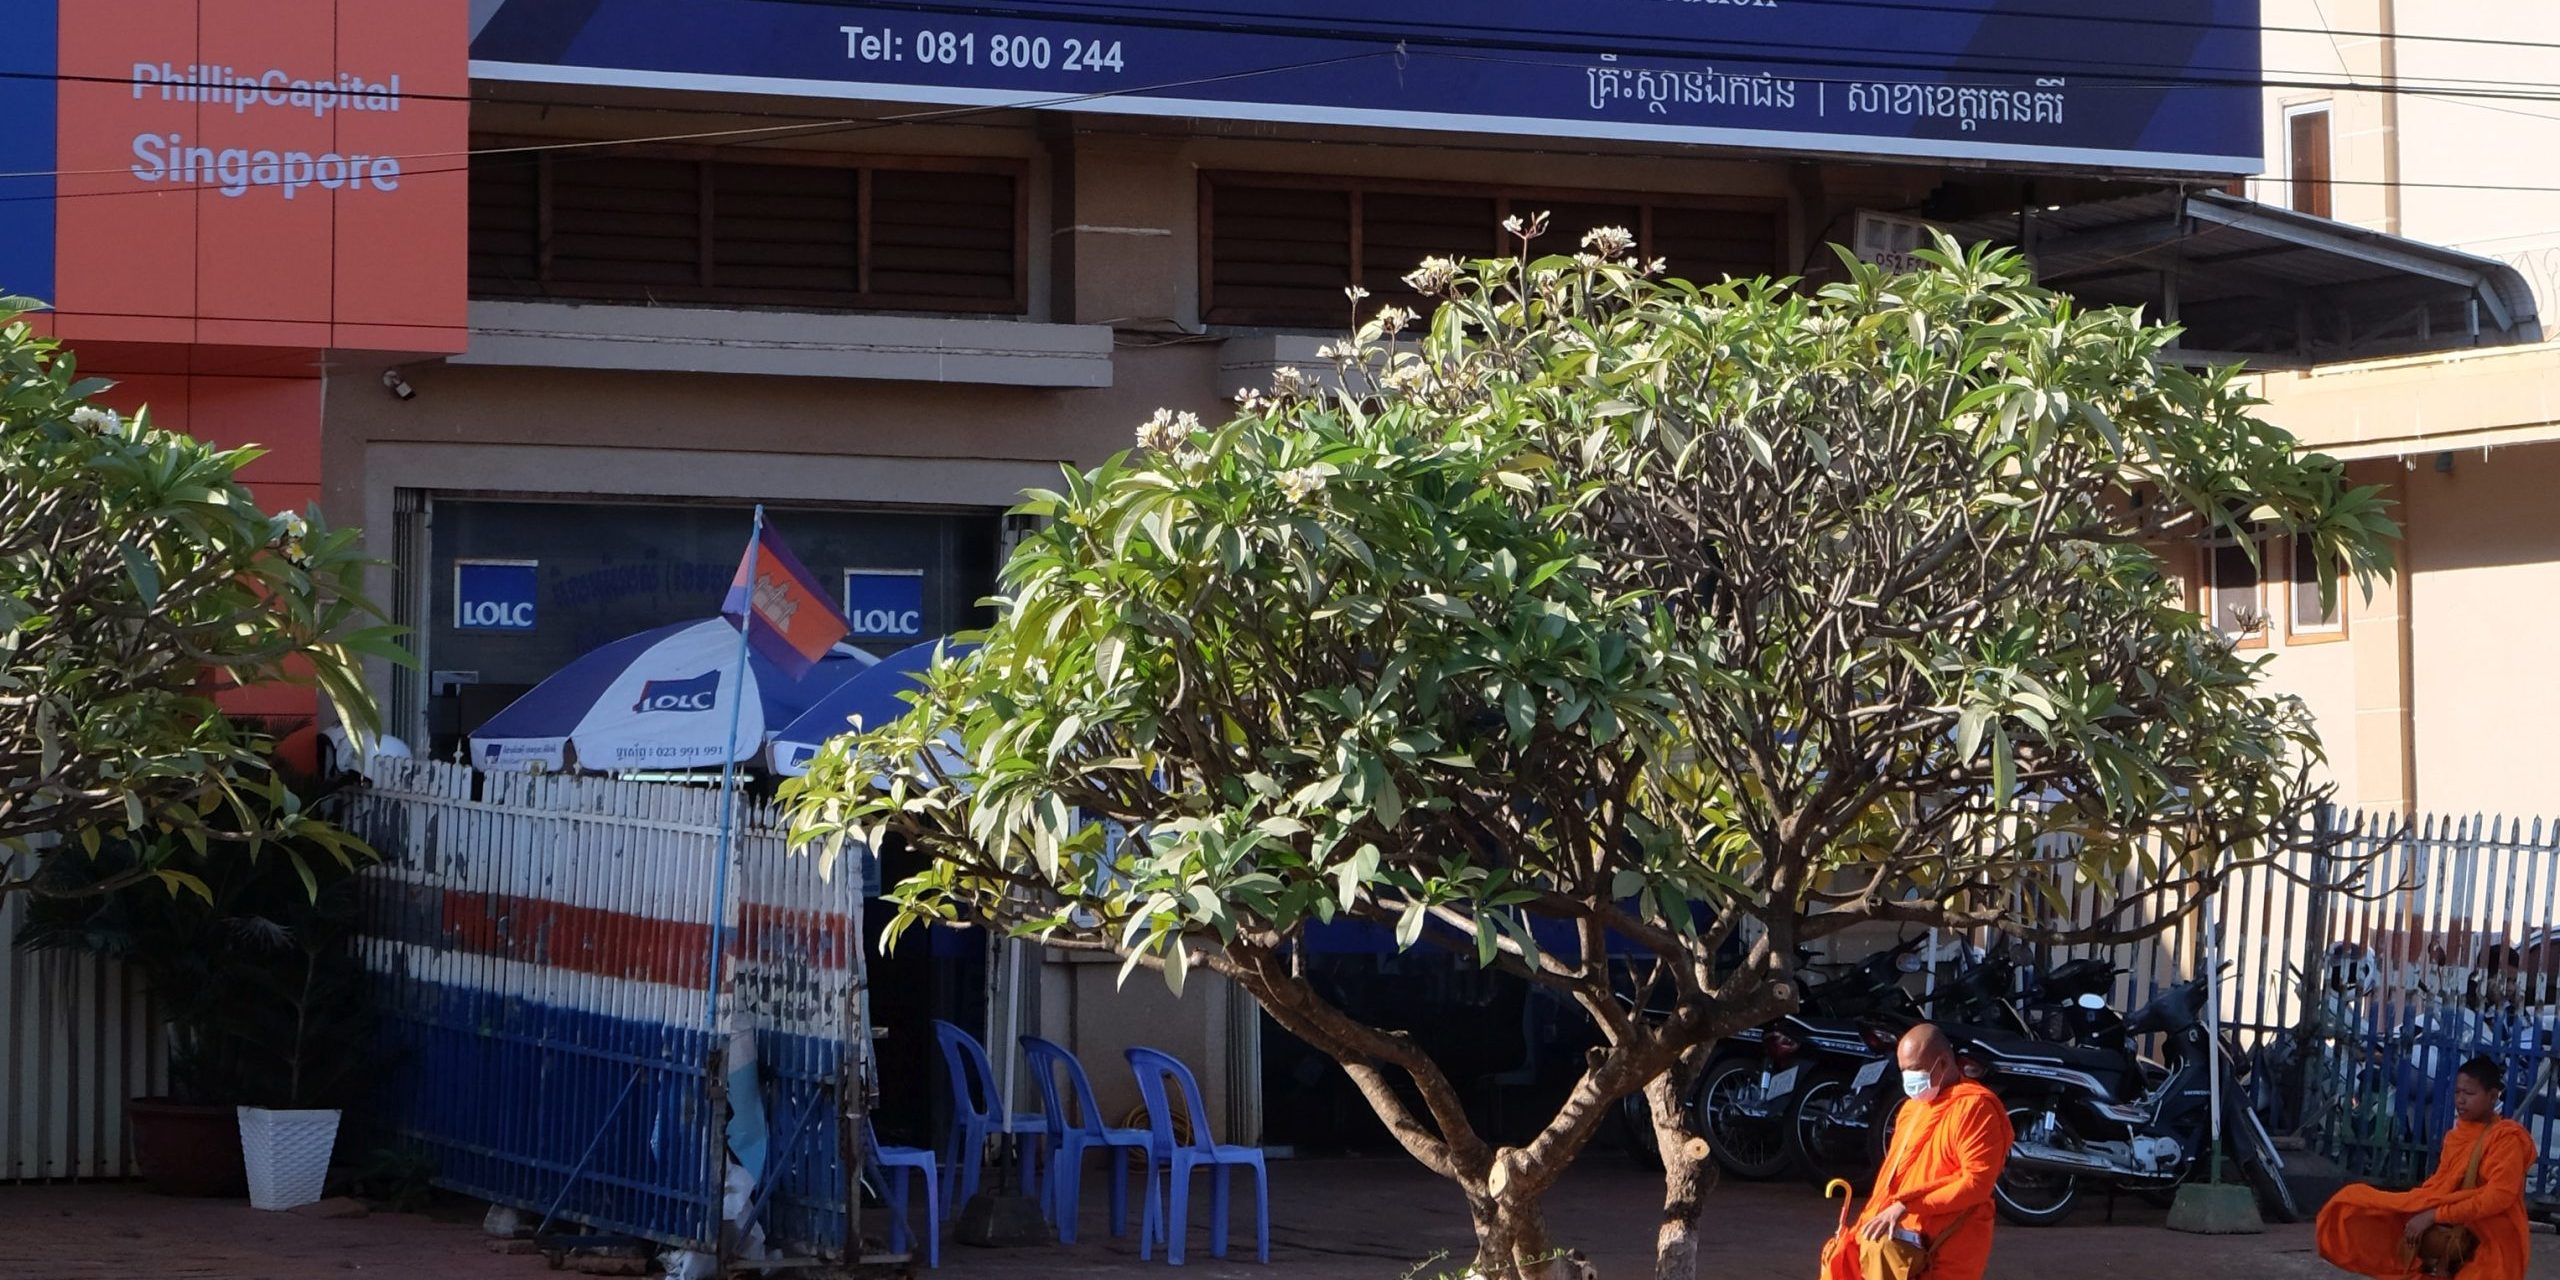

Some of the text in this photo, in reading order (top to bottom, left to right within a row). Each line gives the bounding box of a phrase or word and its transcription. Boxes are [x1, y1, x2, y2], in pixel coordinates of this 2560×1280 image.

[840, 26, 1124, 73] Tel: 081 800 244
[132, 63, 399, 117] PhillipCapital
[131, 133, 399, 200] Singapore
[463, 601, 533, 626] LOLC
[853, 609, 919, 634] LOLC
[642, 691, 712, 711] LOLC
